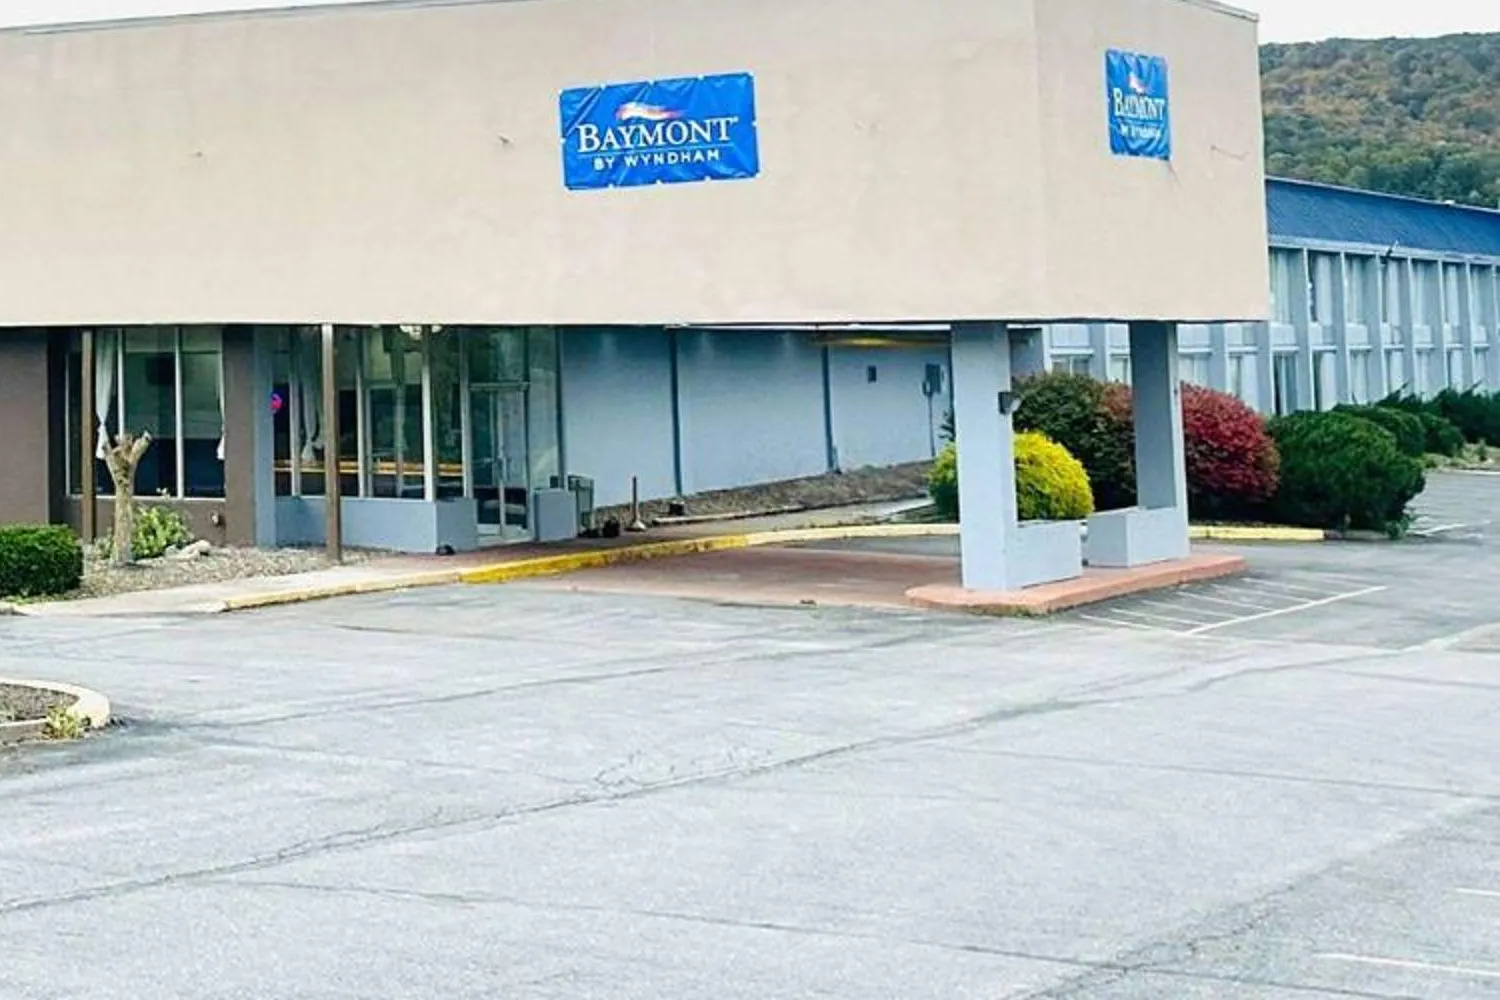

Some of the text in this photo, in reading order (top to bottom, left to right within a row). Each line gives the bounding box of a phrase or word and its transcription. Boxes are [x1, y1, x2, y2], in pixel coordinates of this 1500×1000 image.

[577, 117, 734, 152] BAYMONT
[593, 149, 720, 170] BY WYNDHAM
